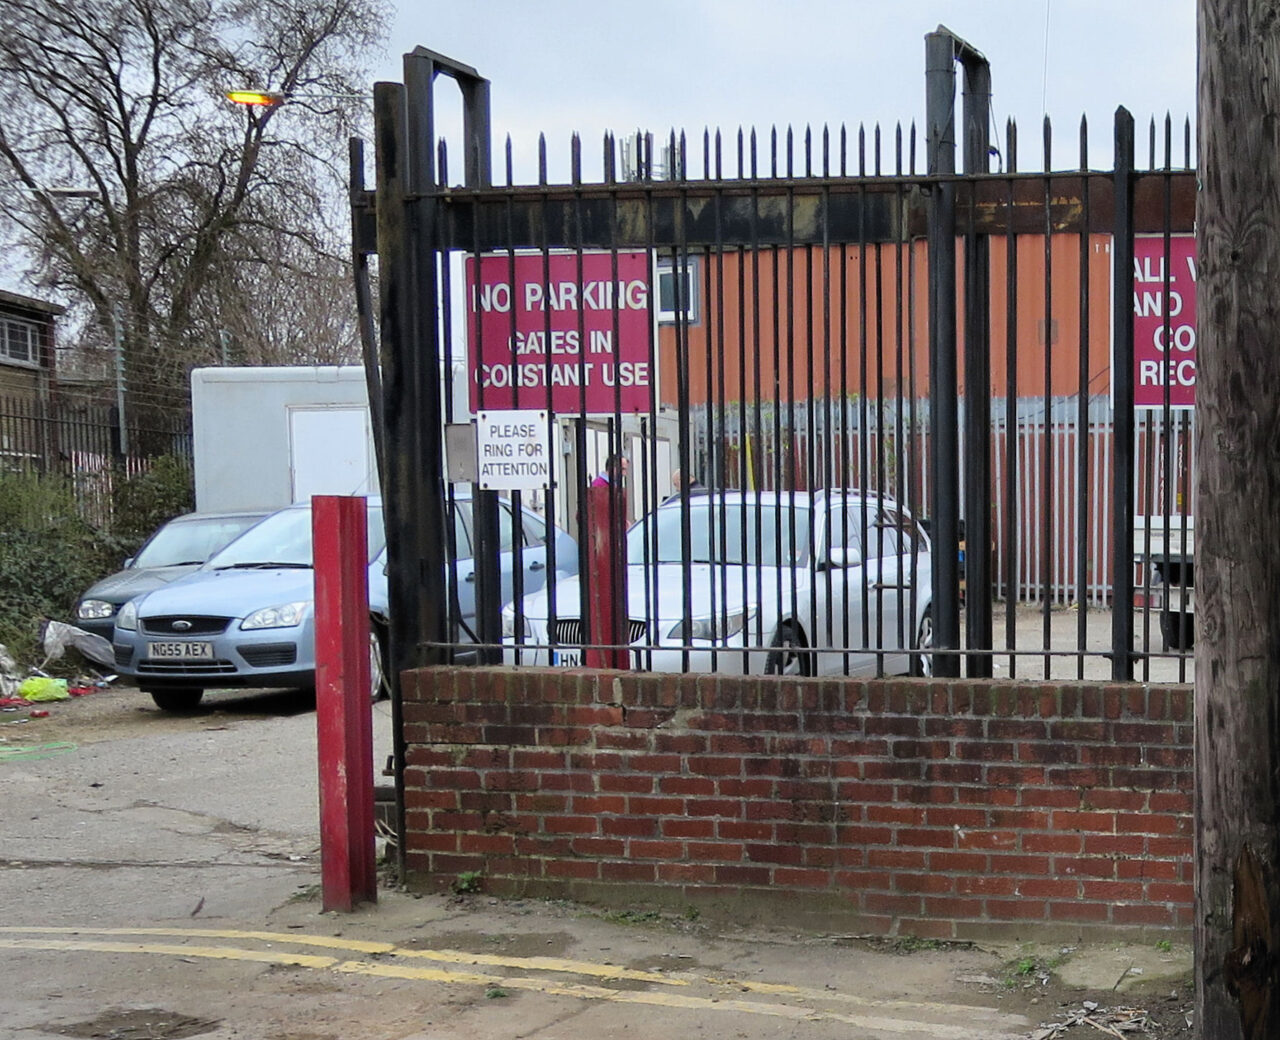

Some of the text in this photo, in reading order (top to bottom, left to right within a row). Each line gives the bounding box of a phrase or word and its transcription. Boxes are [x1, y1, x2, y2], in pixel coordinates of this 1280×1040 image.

[472, 280, 648, 313] NO PARKING
[508, 330, 613, 355] GATES IN
[474, 361, 649, 388] CONSTANT USE
[490, 424, 536, 438] PLEASE
[484, 443, 543, 457] RING FOR
[481, 462, 547, 476] ATTENTION
[152, 643, 208, 657] NG55 AEX
